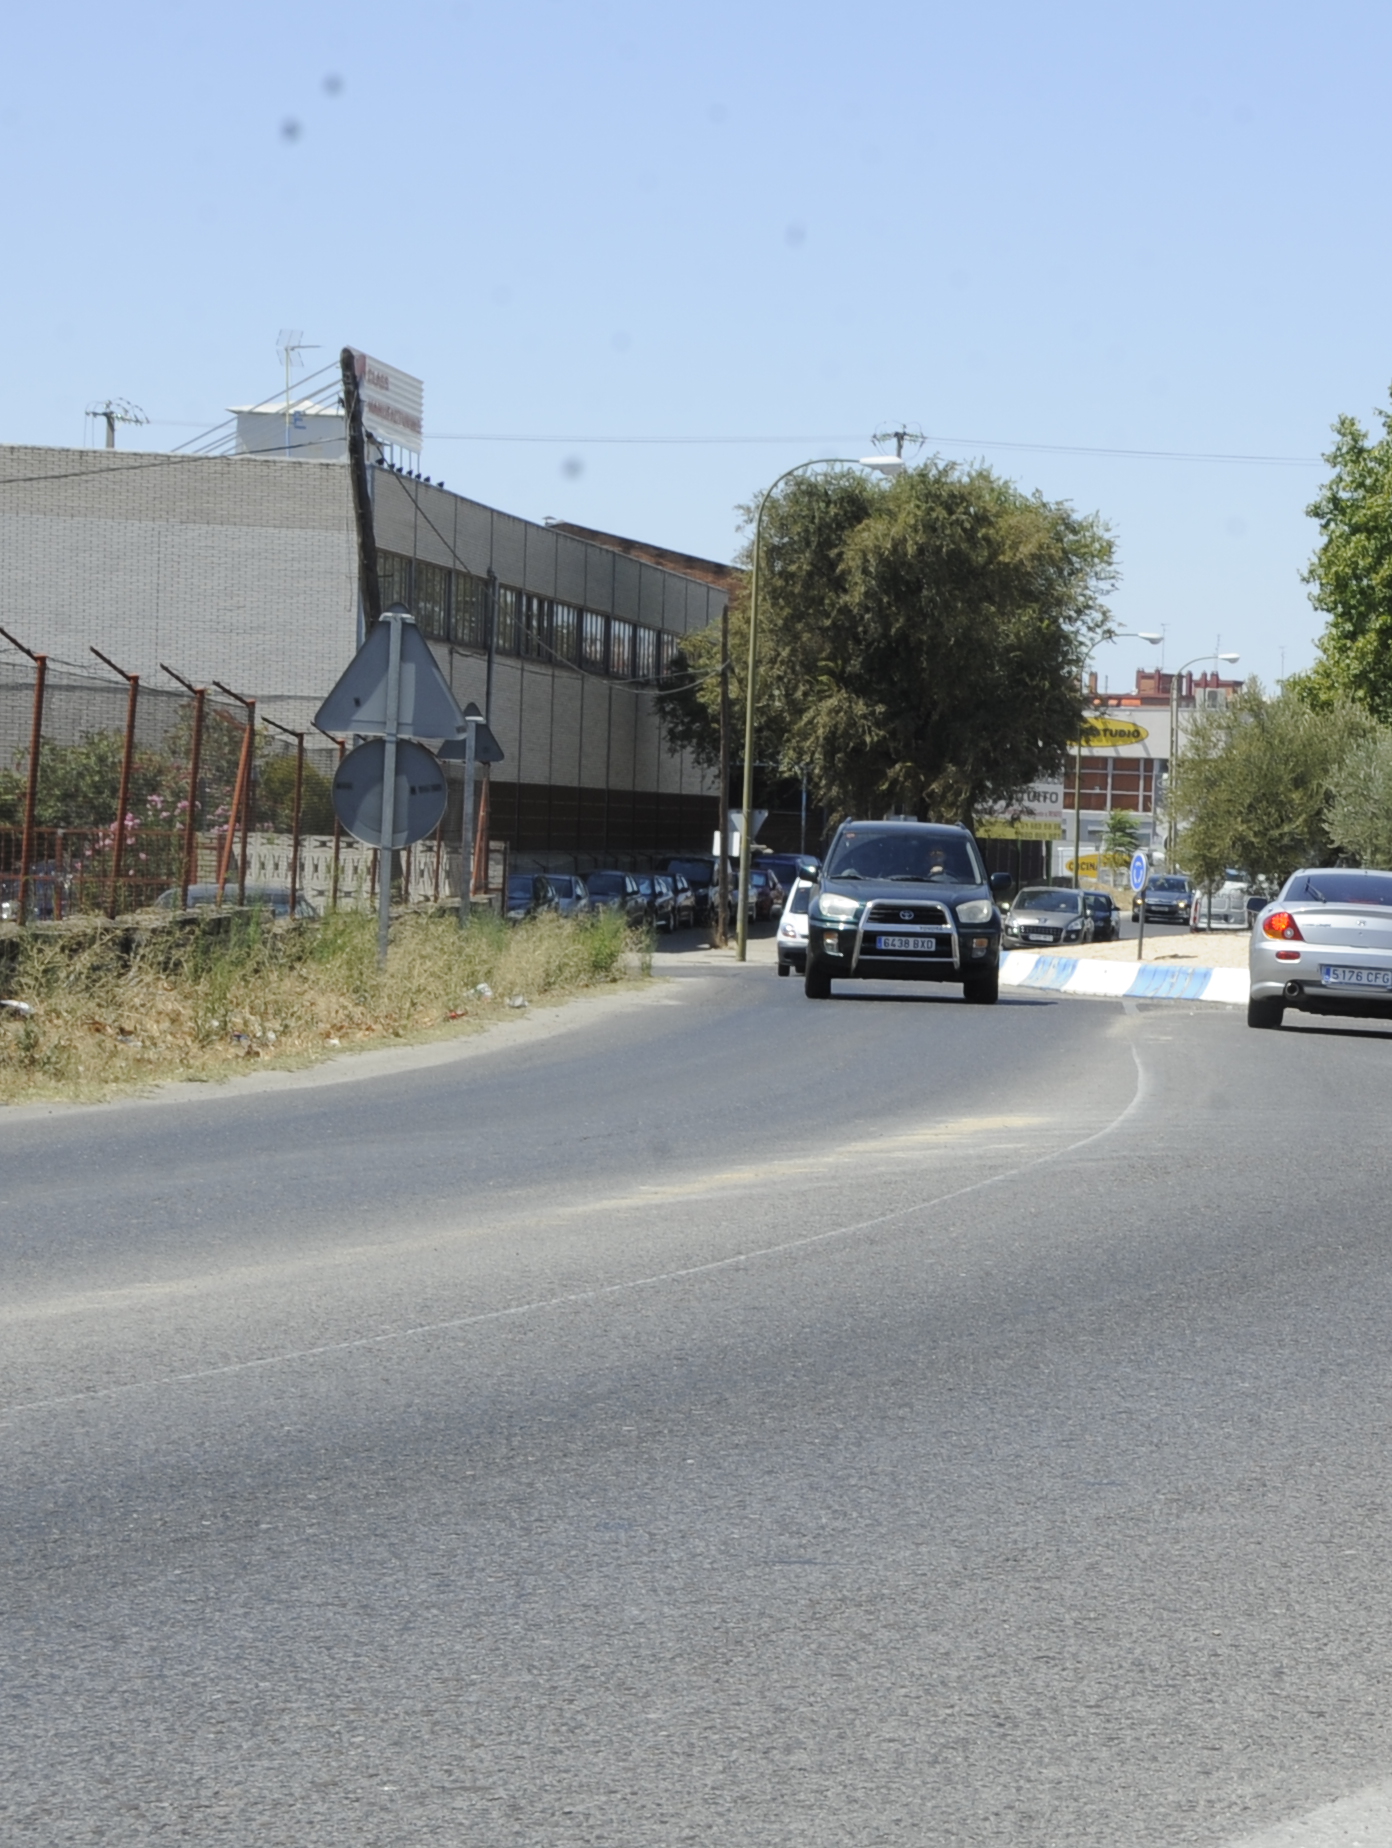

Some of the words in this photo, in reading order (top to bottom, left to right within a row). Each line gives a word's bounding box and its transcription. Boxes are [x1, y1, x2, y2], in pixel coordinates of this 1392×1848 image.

[883, 938, 910, 949] 6438
[912, 939, 934, 949] BXD
[1331, 968, 1363, 983] 5176
[1366, 970, 1391, 984] CFG
